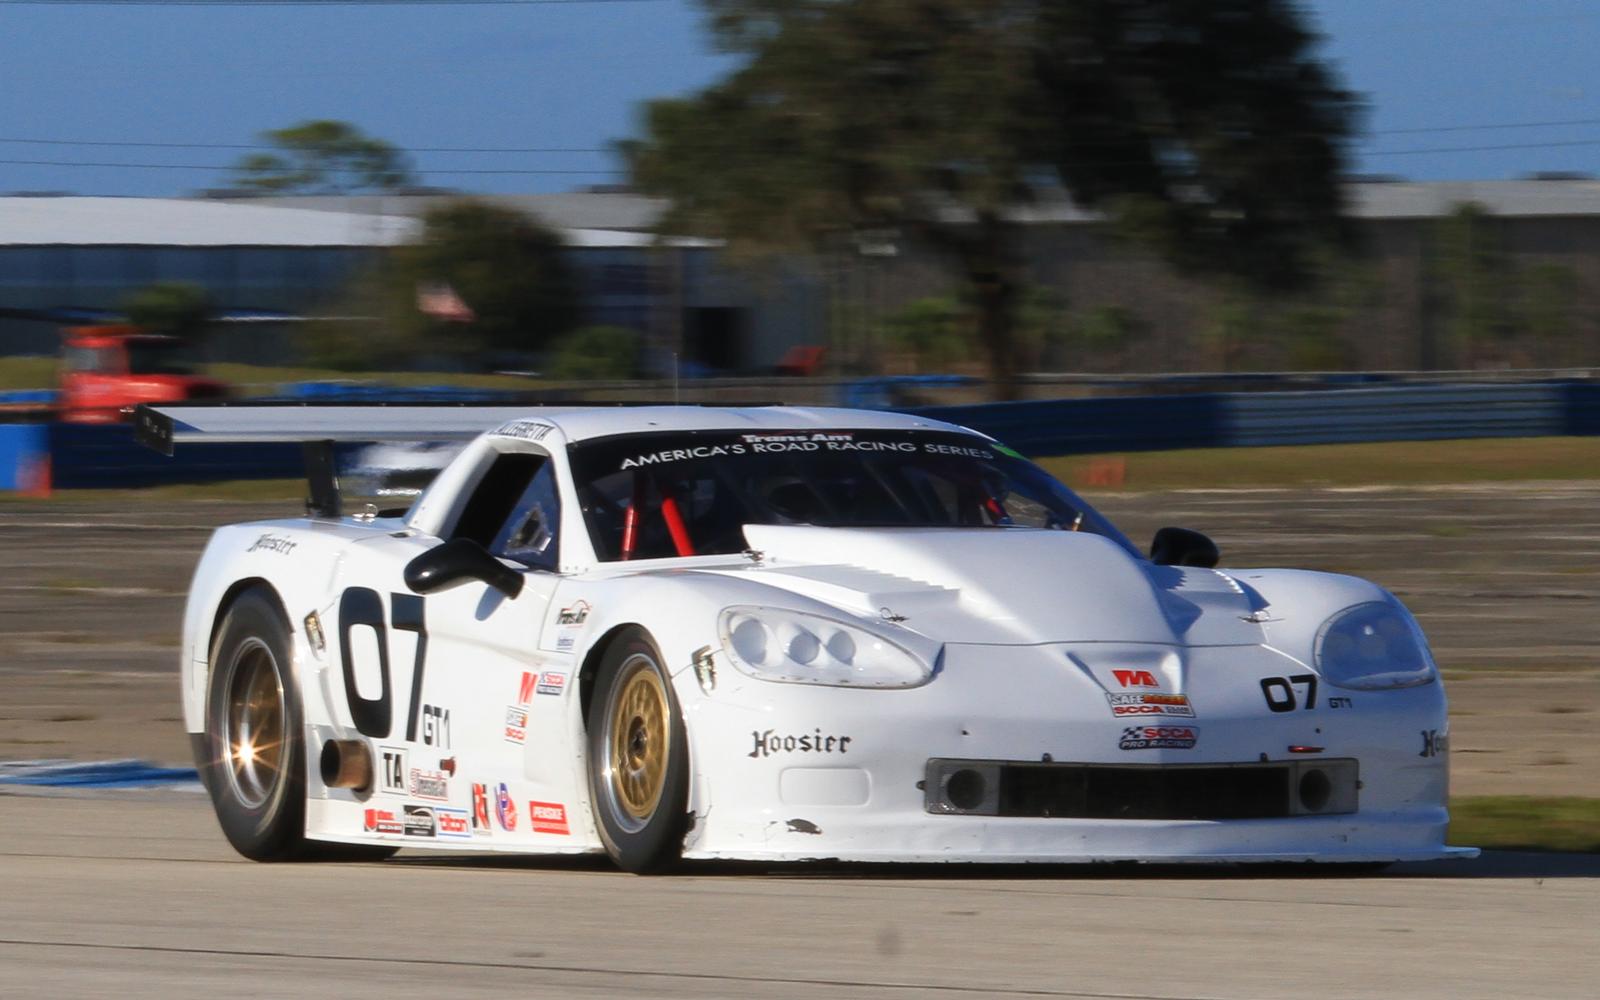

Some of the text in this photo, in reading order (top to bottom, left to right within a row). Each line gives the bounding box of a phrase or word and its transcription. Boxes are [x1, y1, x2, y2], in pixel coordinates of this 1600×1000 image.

[741, 433, 853, 443] Trans Am
[620, 441, 994, 470] AMERICA'S ROAD RACING SERIES
[338, 586, 428, 742] 07
[1260, 674, 1353, 713] 07 GT1
[1113, 705, 1165, 715] SCCA
[424, 704, 451, 750] GT1
[1143, 728, 1195, 739] SCCA
[748, 727, 852, 758] Hoosier
[1121, 740, 1147, 750] PRO
[383, 752, 404, 789] TA
